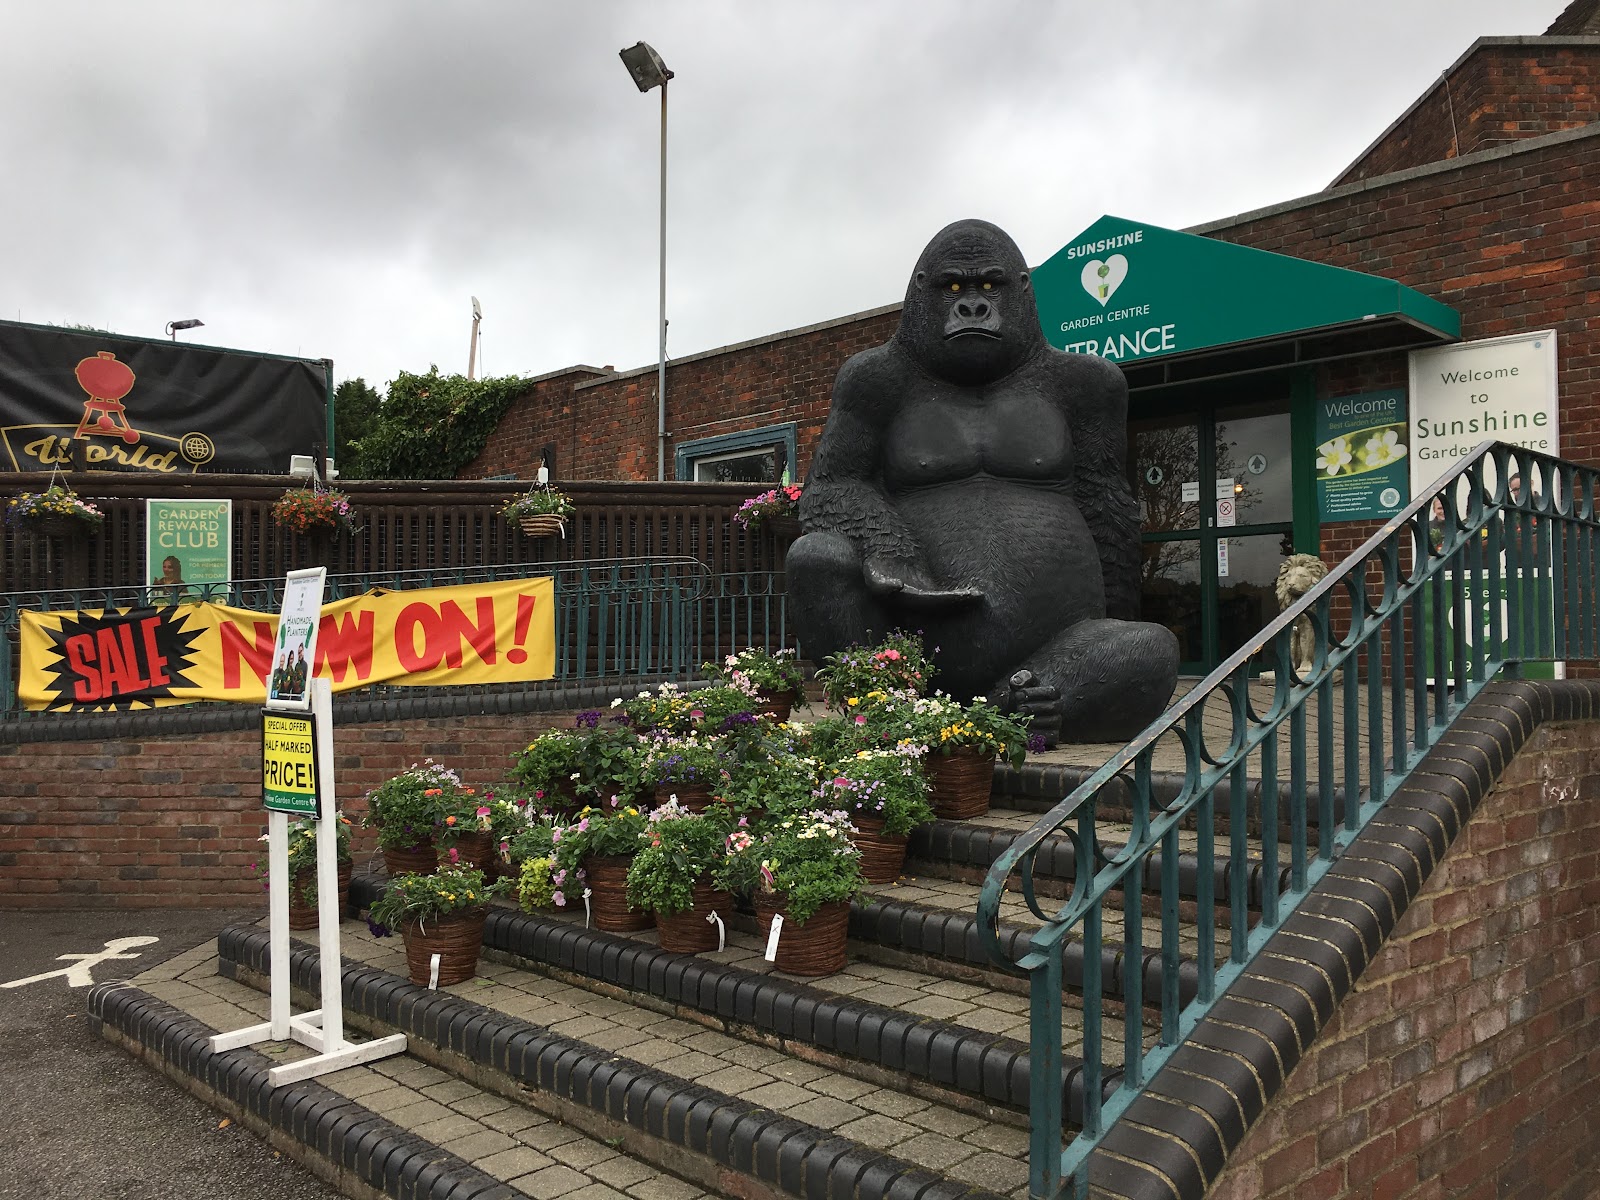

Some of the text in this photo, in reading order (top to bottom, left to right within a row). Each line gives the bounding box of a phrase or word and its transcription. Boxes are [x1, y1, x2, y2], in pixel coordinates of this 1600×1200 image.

[1067, 230, 1143, 259] SUNSHINE
[1060, 304, 1150, 332] GARDEN CENTRE
[1064, 323, 1175, 359] TRANCE
[1441, 367, 1519, 384] Welcome
[1325, 398, 1396, 417] Welcome
[1470, 393, 1488, 404] to
[1344, 419, 1370, 428] Garden
[1370, 416, 1396, 425] Centres
[1417, 410, 1547, 439] Sunshine
[24, 435, 178, 473] World
[159, 509, 219, 520] GARDEN
[159, 521, 219, 531] REWARD
[159, 532, 219, 548] CLUB
[64, 594, 535, 703] SALE NW ON!
[268, 720, 307, 732] SPECIAL OFFER
[280, 741, 312, 753] MARKED
[265, 759, 313, 788] PRICE!
